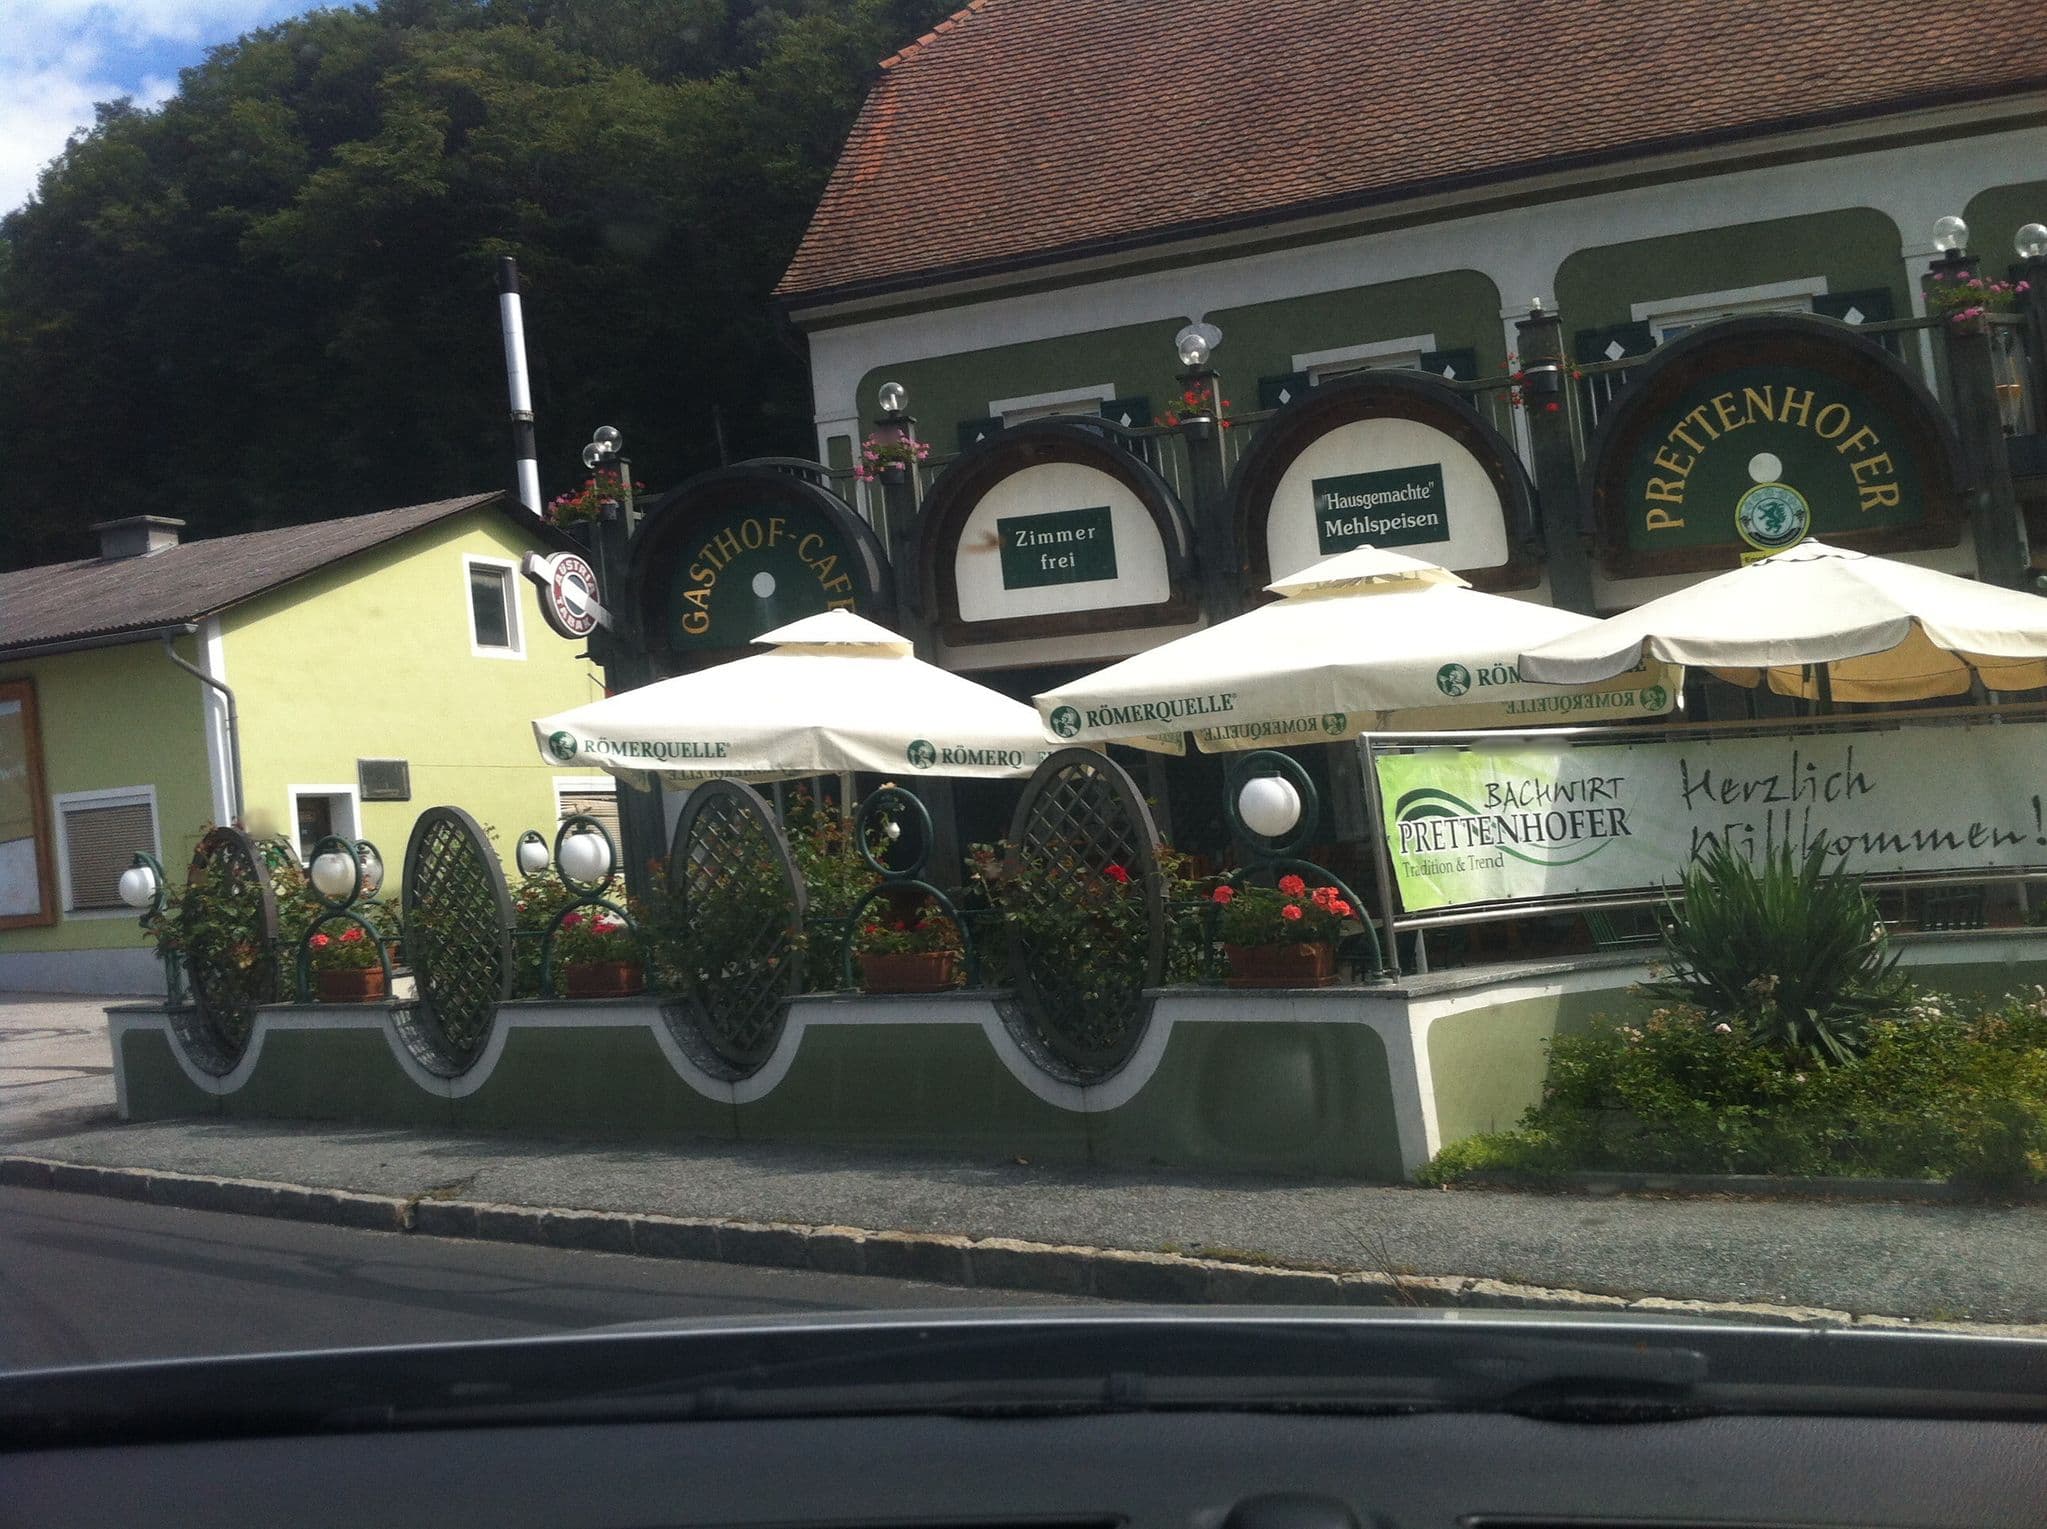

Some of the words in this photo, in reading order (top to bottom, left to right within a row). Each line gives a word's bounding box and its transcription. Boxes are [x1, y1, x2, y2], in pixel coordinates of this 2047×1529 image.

[1645, 385, 1900, 532] PRETTENHOFER
[1015, 527, 1096, 547] Zimmer
[1325, 513, 1439, 538] Mehlspeisen
[555, 560, 597, 594] AUSTRIA
[1040, 552, 1076, 570] frei
[1086, 693, 1235, 728] RÖMERQUELLE
[584, 738, 728, 761] RÖMERQUELLE
[1484, 777, 1625, 812] BACHWIRT
[1680, 745, 1877, 810] Herzlich
[1399, 808, 1632, 854] PRETTENHOFER
[1402, 858, 1453, 878] Tradition
[1456, 857, 1466, 872] &
[1468, 852, 1504, 870] Trend
